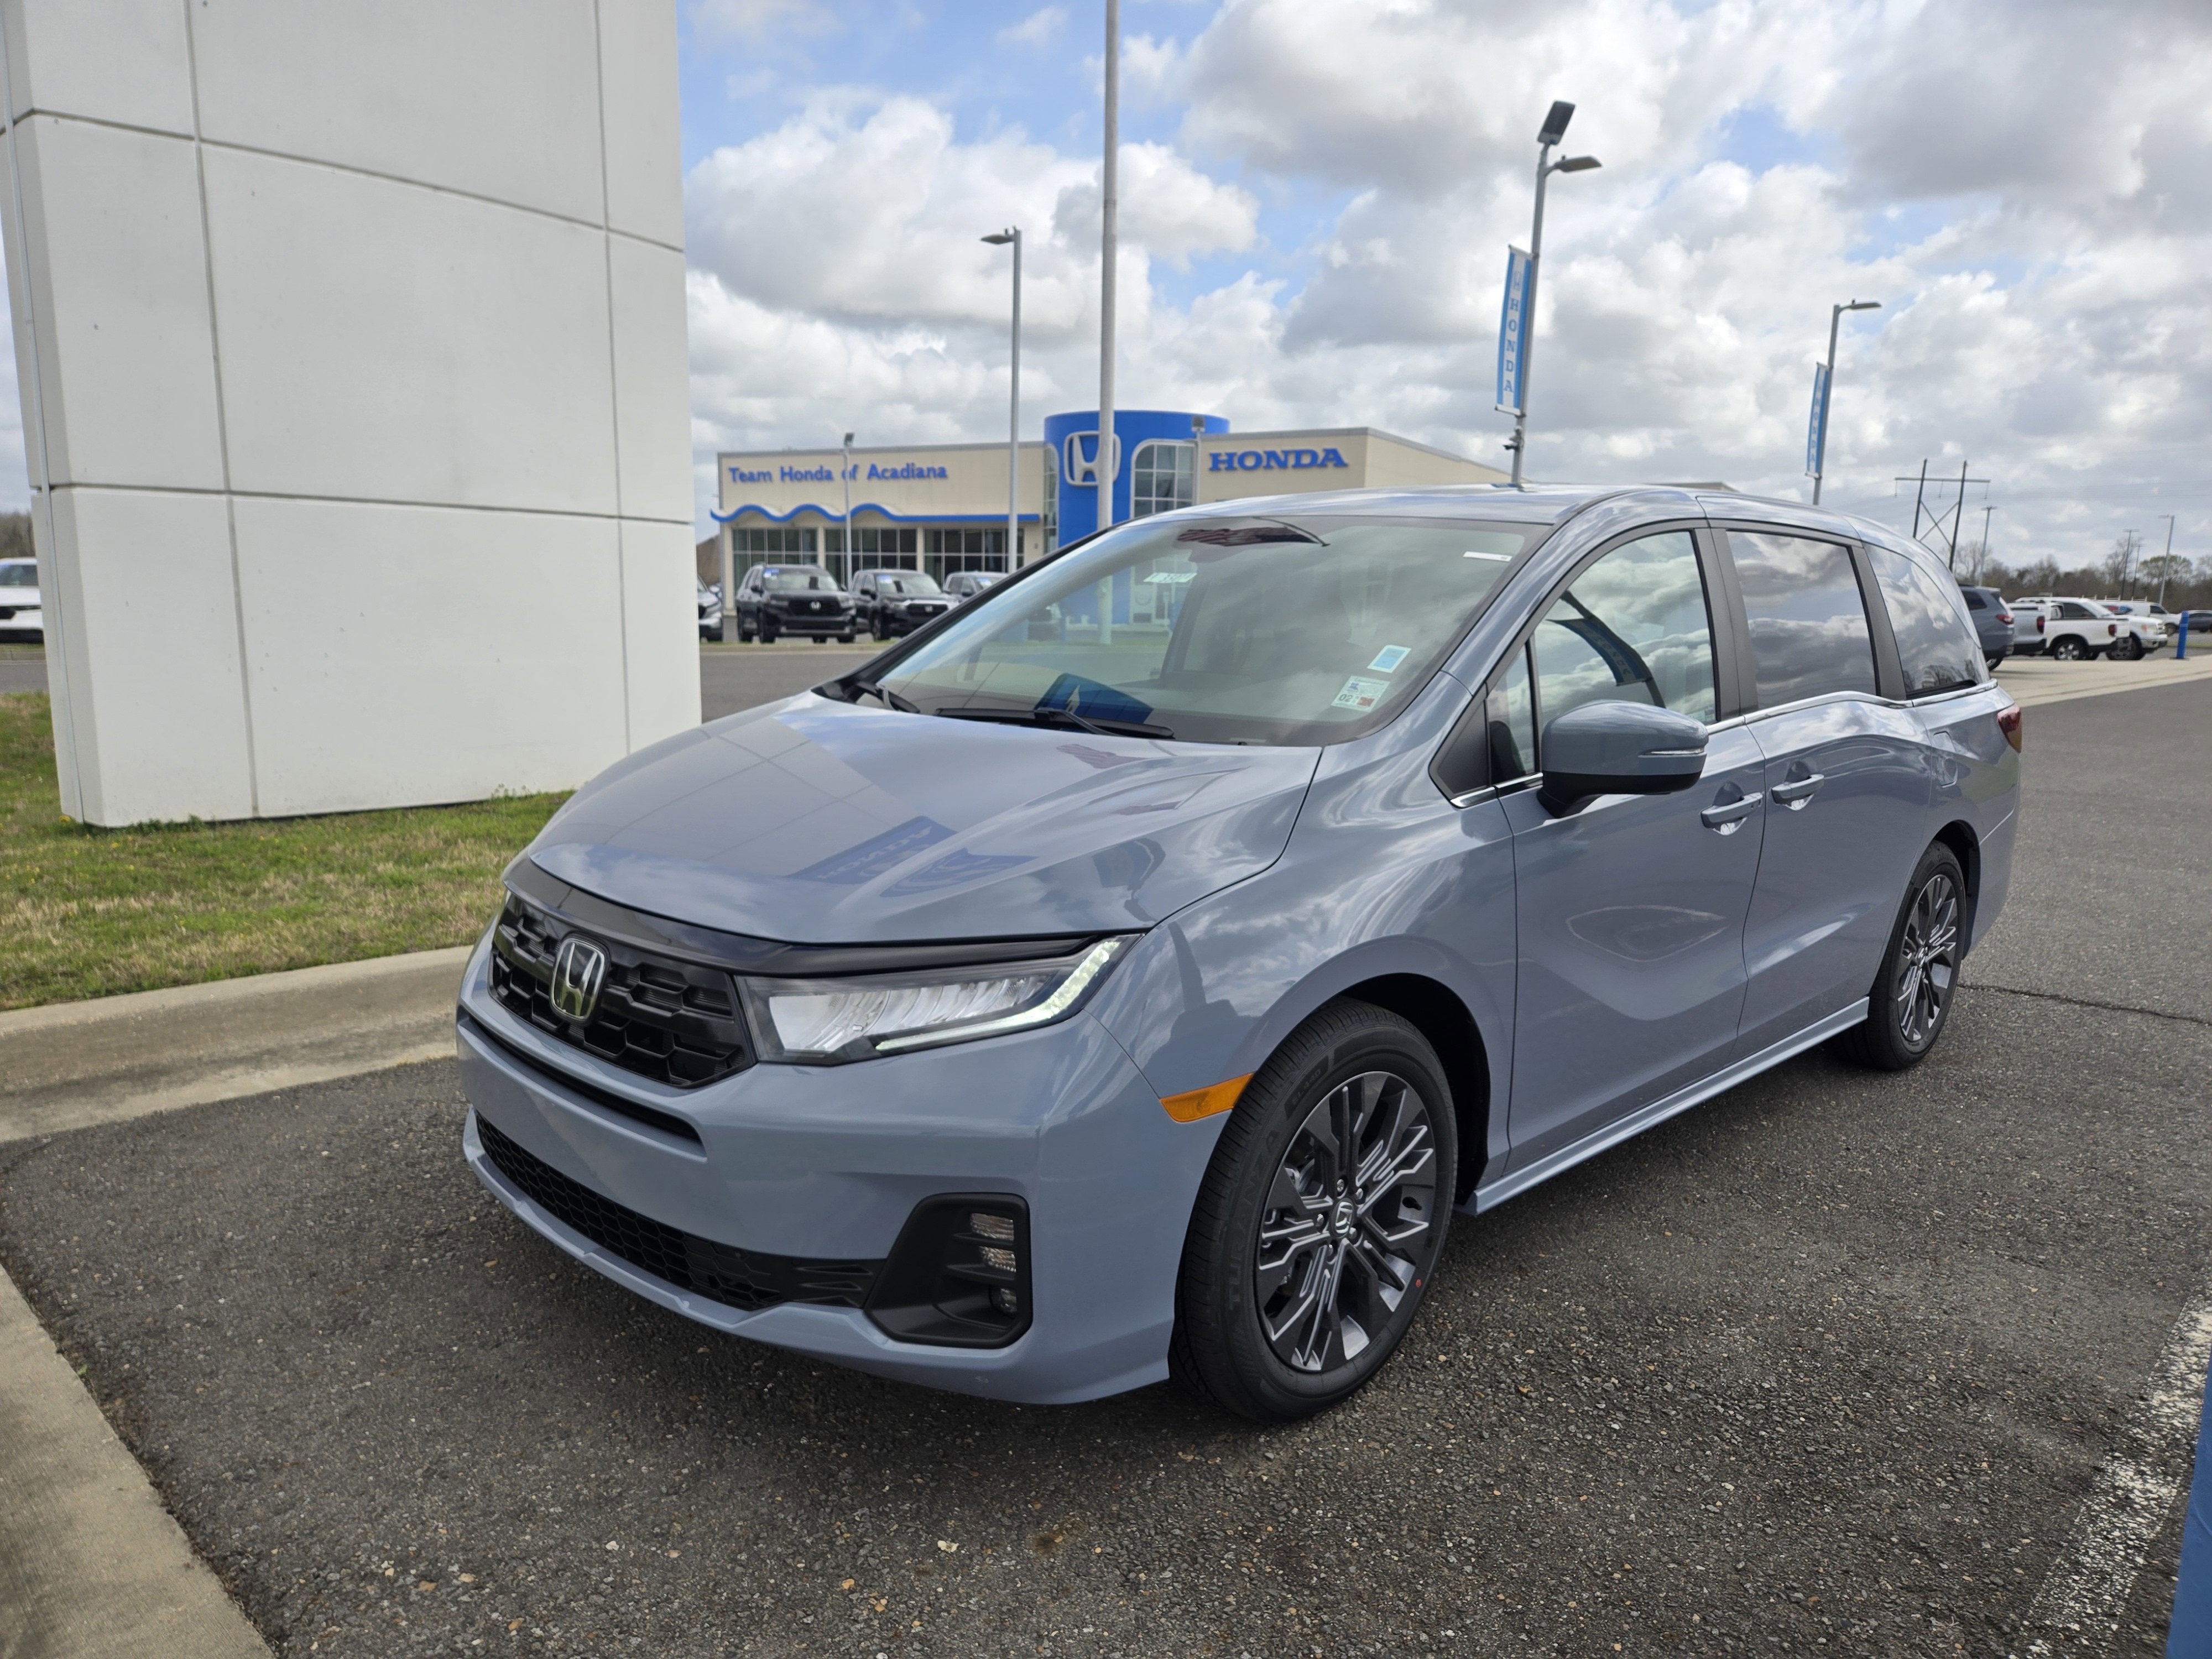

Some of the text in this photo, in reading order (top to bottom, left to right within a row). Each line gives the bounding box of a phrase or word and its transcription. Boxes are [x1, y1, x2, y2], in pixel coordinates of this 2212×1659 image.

[1504, 299, 1519, 392] HONDA
[1209, 448, 1348, 472] HONDA
[728, 467, 772, 483] Team
[780, 466, 832, 481] Honda
[867, 463, 947, 480] Acadiana
